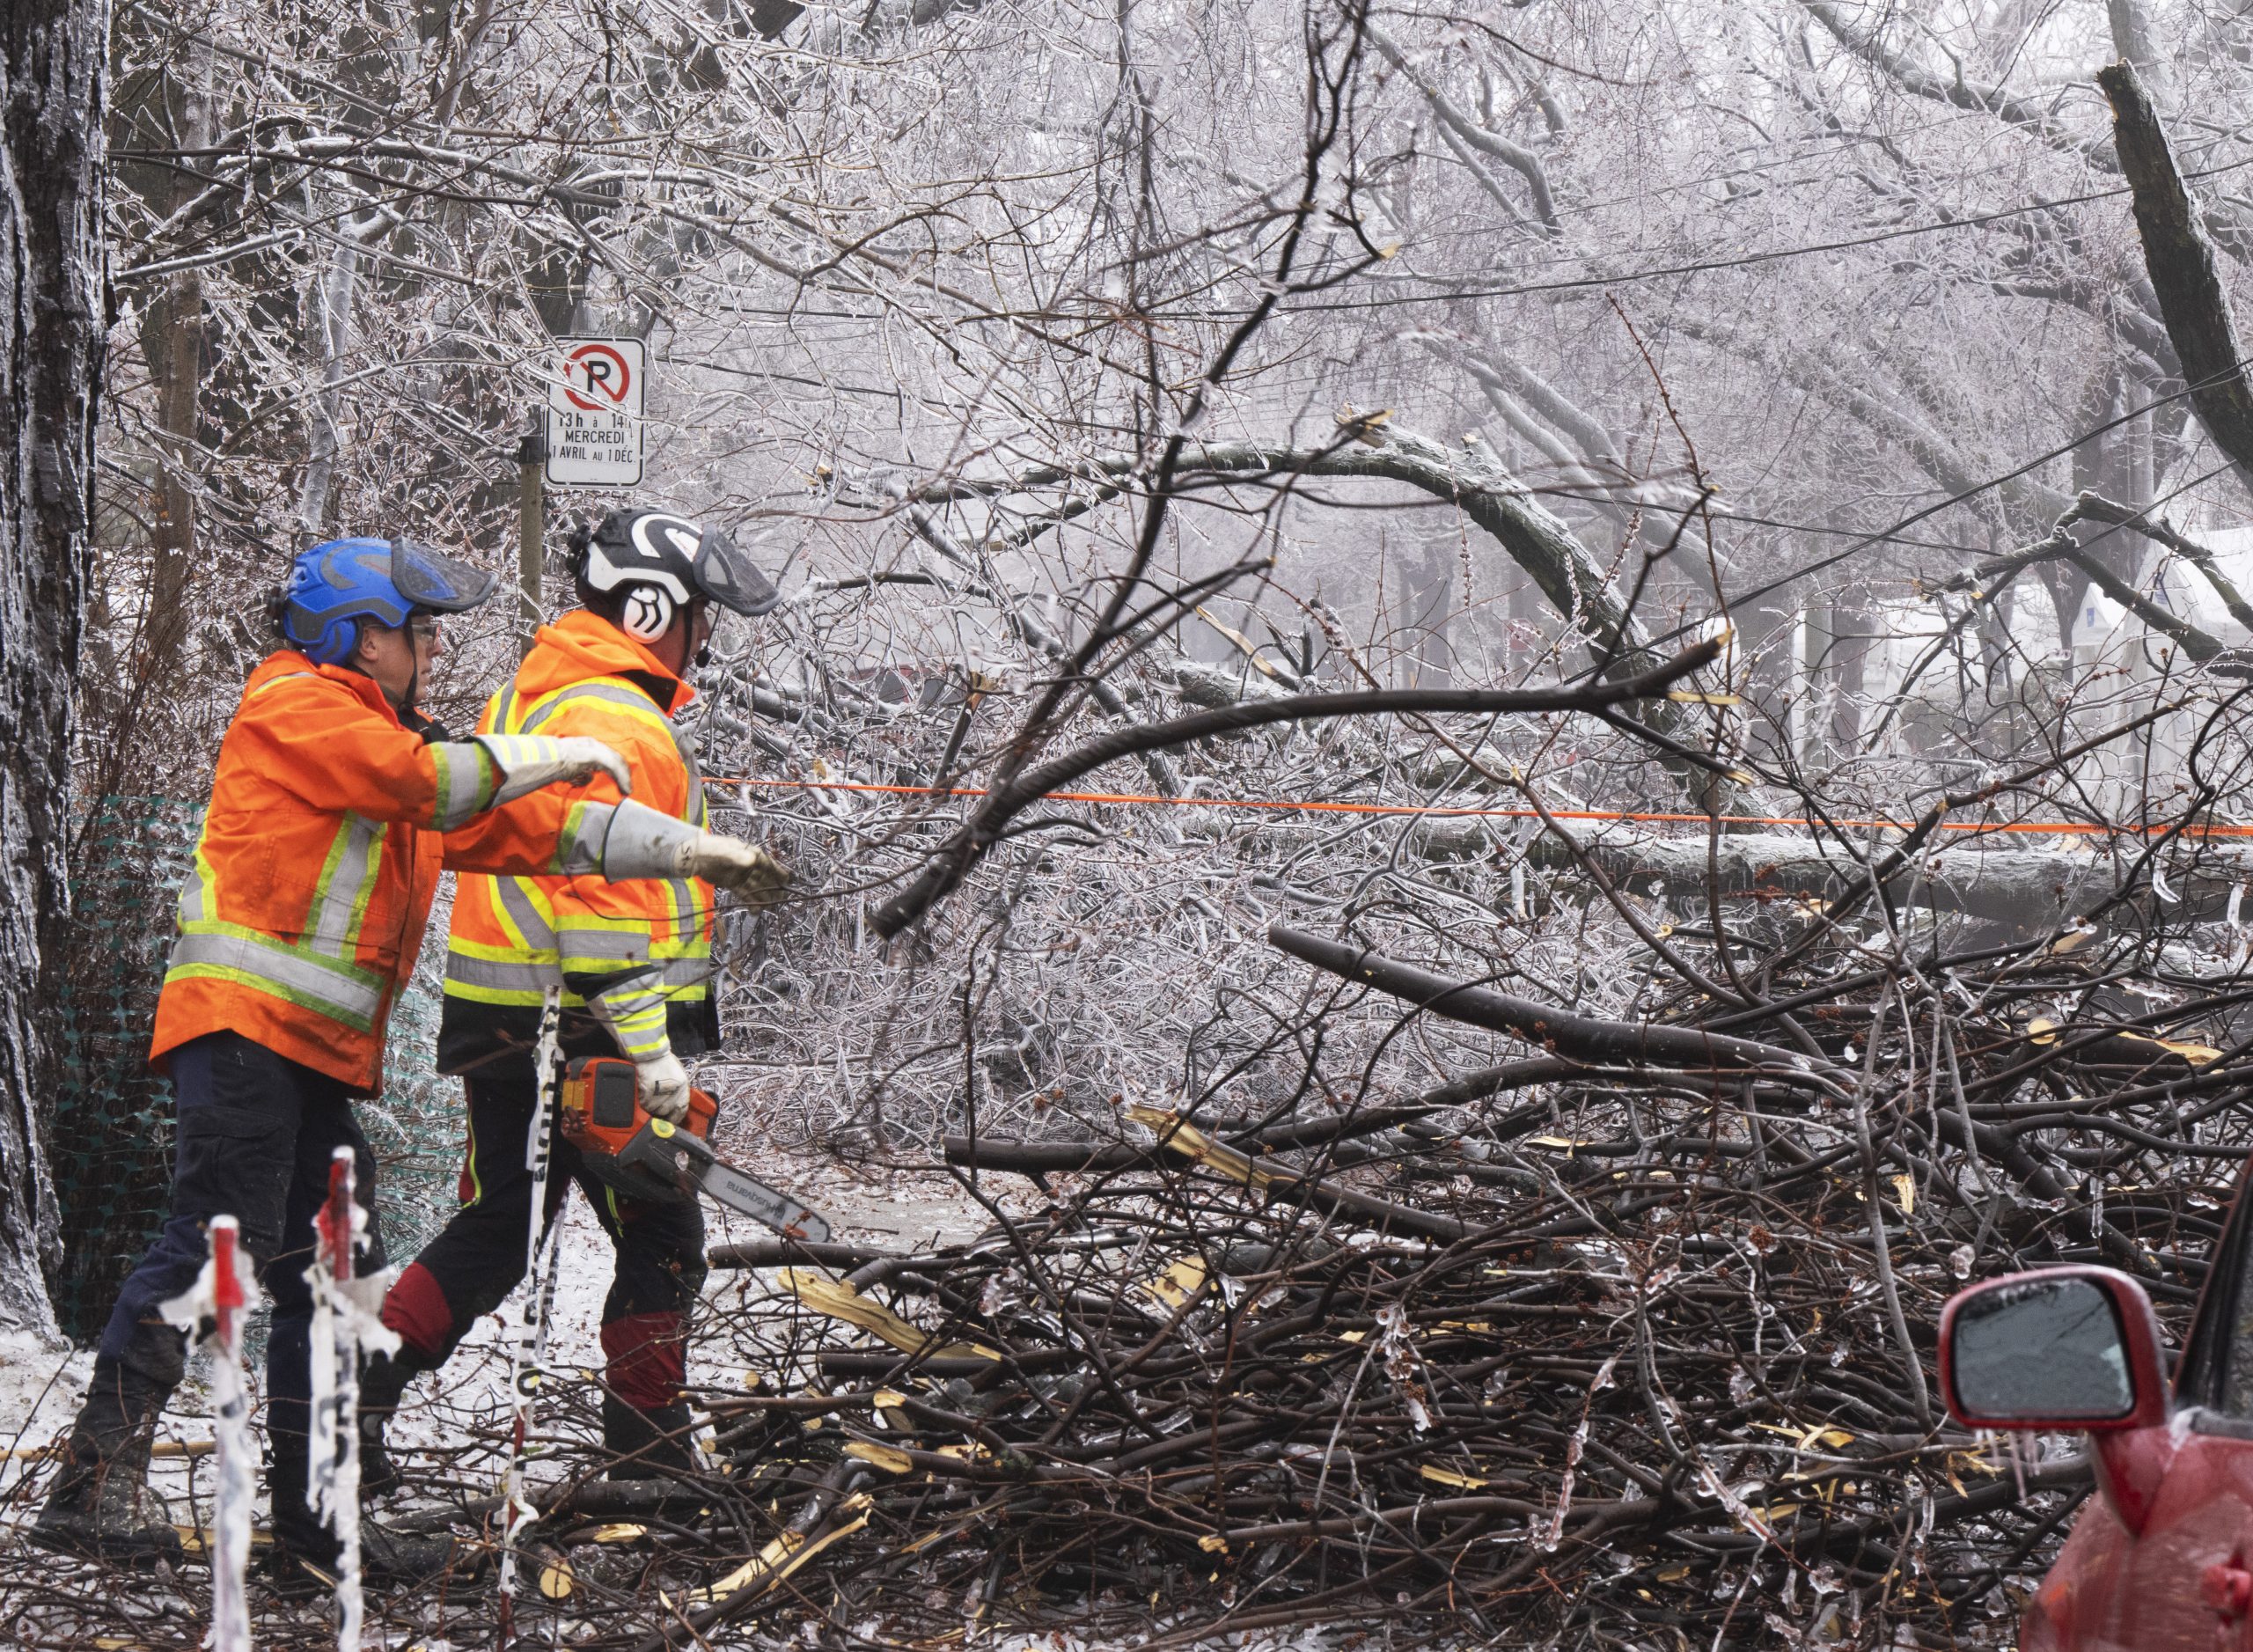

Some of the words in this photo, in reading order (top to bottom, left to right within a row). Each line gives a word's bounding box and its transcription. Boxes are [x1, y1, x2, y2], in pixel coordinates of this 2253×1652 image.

[592, 416, 598, 428] à
[565, 430, 624, 444] MERCREDI
[553, 445, 556, 458] 1
[560, 445, 587, 459] AVRIL
[592, 451, 603, 461] AU
[726, 1181, 776, 1214] Husqvarna
